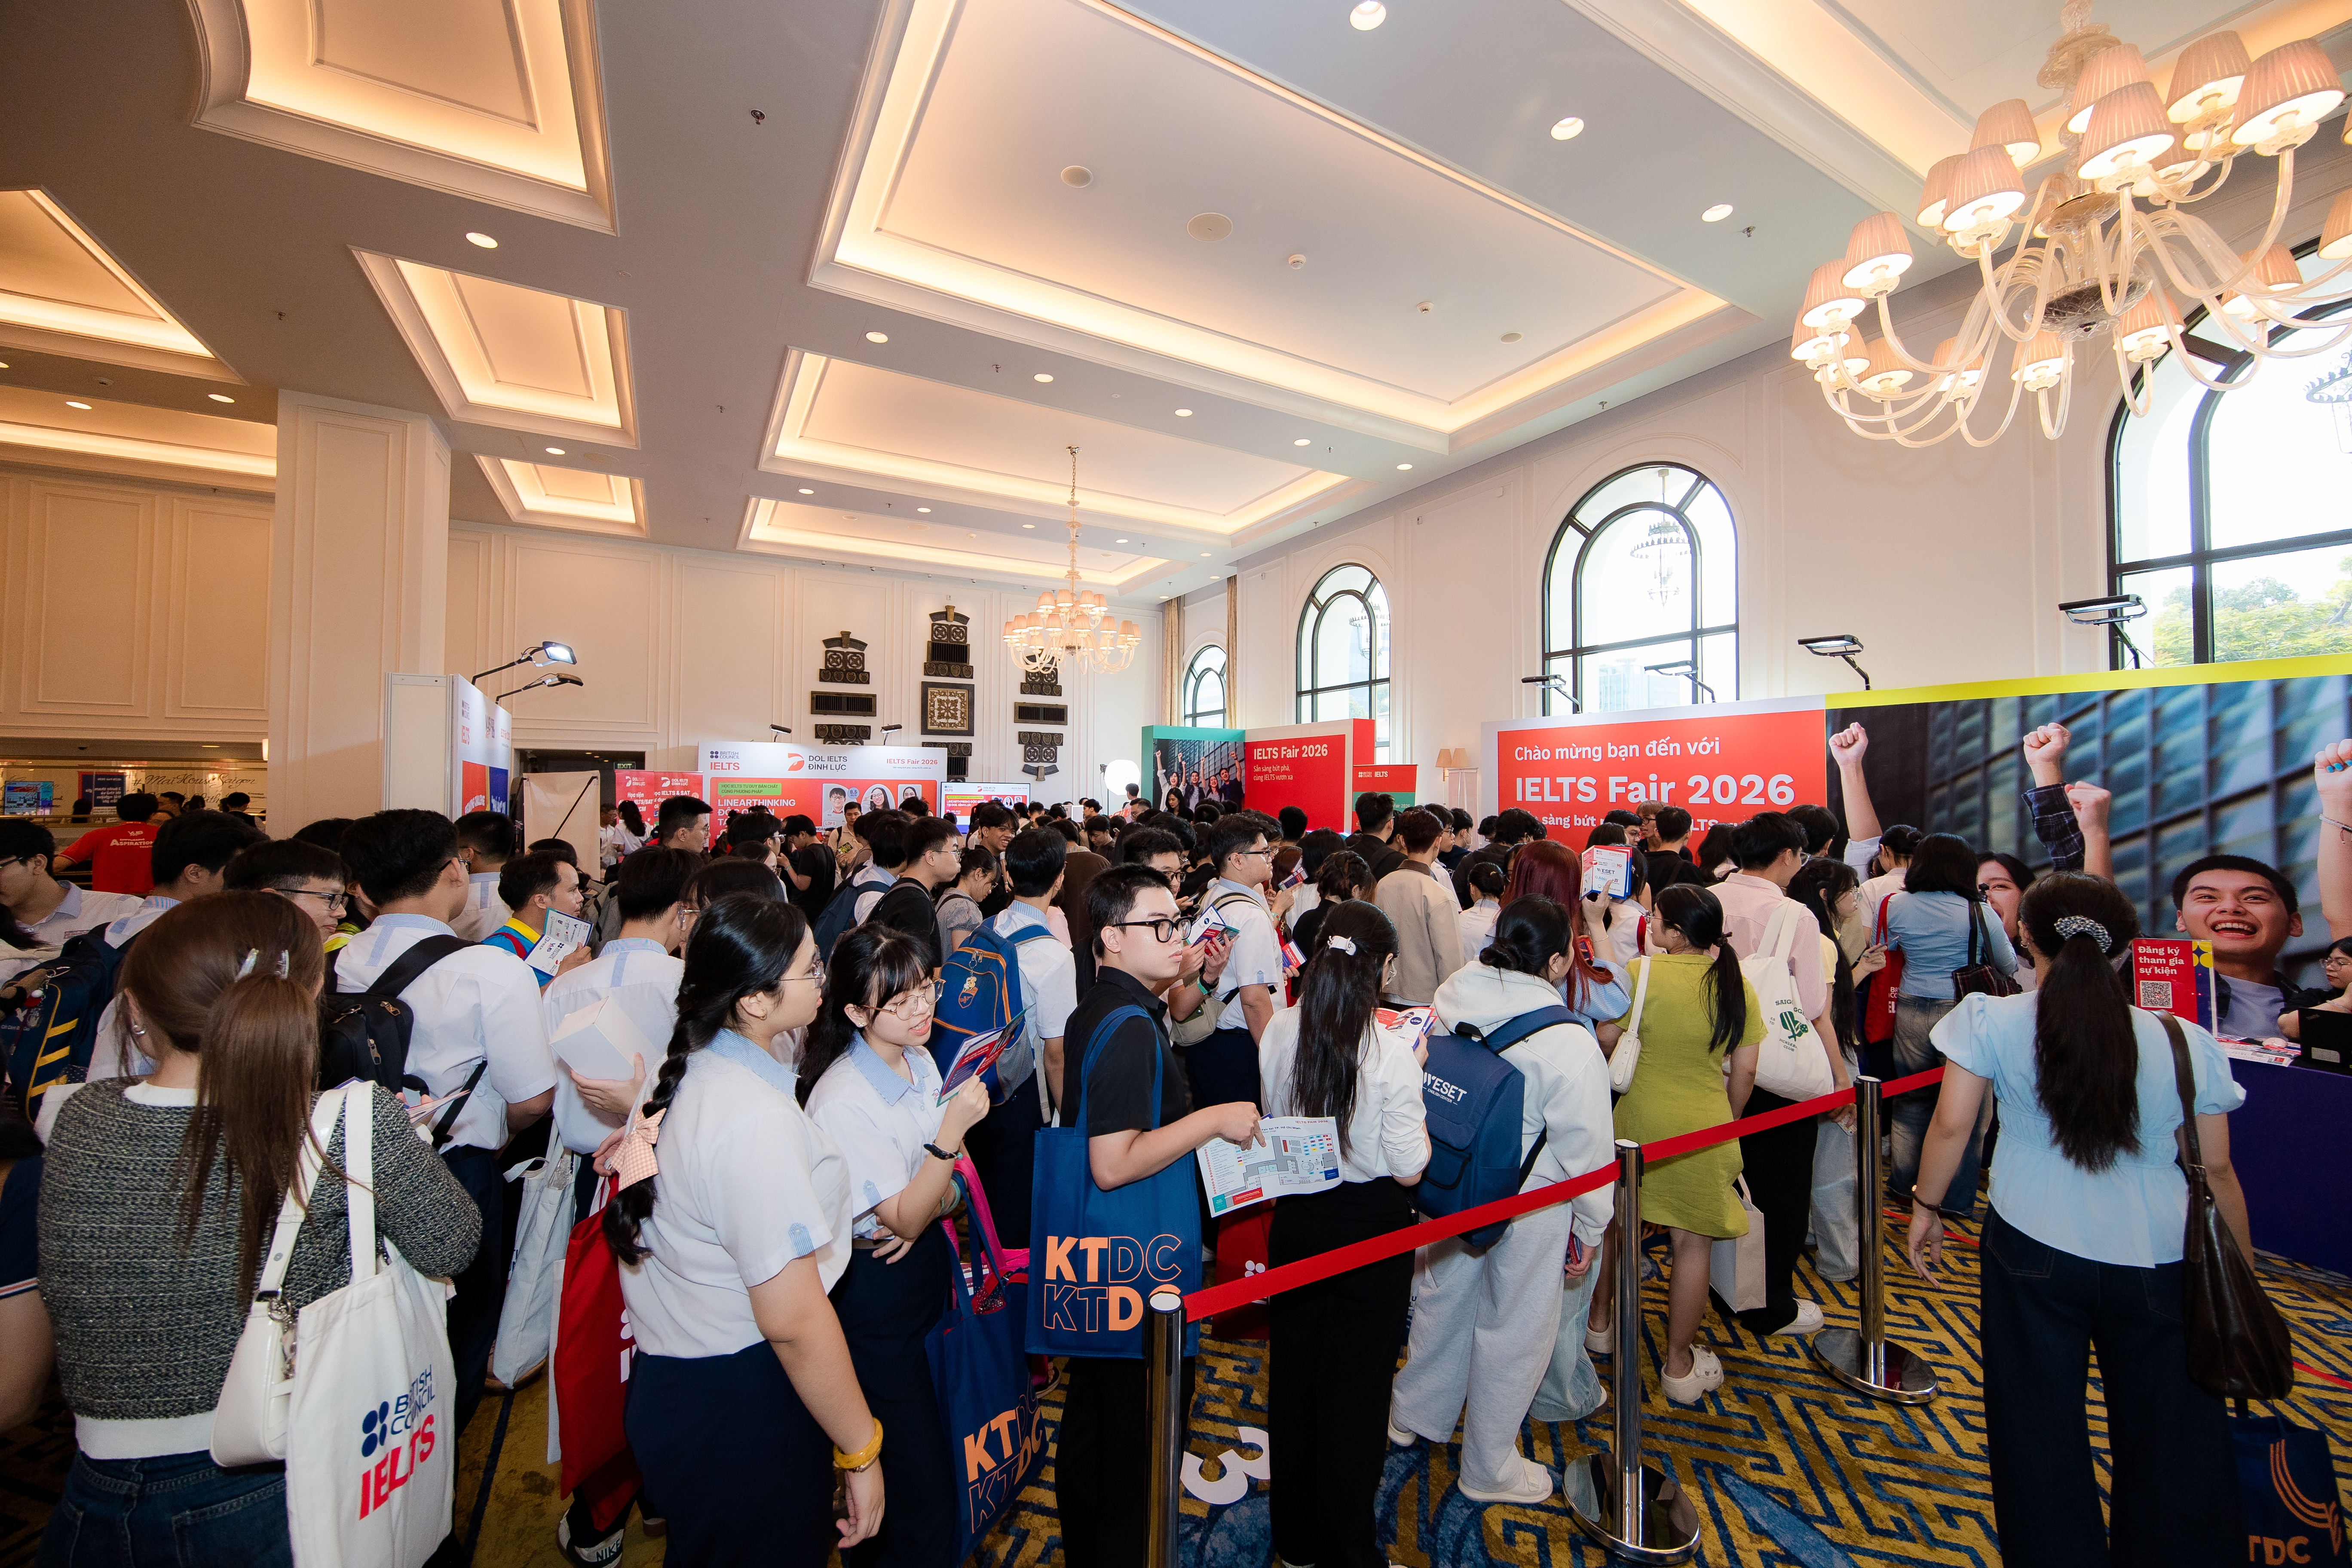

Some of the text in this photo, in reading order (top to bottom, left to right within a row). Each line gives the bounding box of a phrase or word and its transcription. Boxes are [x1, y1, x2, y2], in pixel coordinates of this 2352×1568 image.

[1254, 744, 1328, 760] IELTS Fair 2026
[1515, 736, 1720, 762] Chào mừng bạn đến với
[710, 762, 740, 770] IELTS
[830, 764, 846, 772] LỰC
[1262, 765, 1271, 773] sàng
[1281, 764, 1290, 772] phá,
[1516, 774, 1795, 805] IELTS Fair 2026
[717, 799, 796, 807] LINEARTHINKING
[1542, 814, 1570, 829] sàng
[1574, 814, 1596, 827] bứt
[2138, 946, 2180, 956] Đăng ký
[2169, 957, 2184, 966] gia
[2139, 966, 2177, 976] sự kiện
[1424, 1072, 1467, 1102] WESET
[1427, 1088, 1452, 1103] ENGLISH CENTER
[1045, 1234, 1182, 1283] KTDC
[1044, 1284, 1181, 1332] KTD
[394, 1364, 432, 1415] BTISH
[359, 1414, 435, 1521] IELTS
[596, 1538, 620, 1562] NIKE
[2248, 1535, 2311, 1566] TDC
